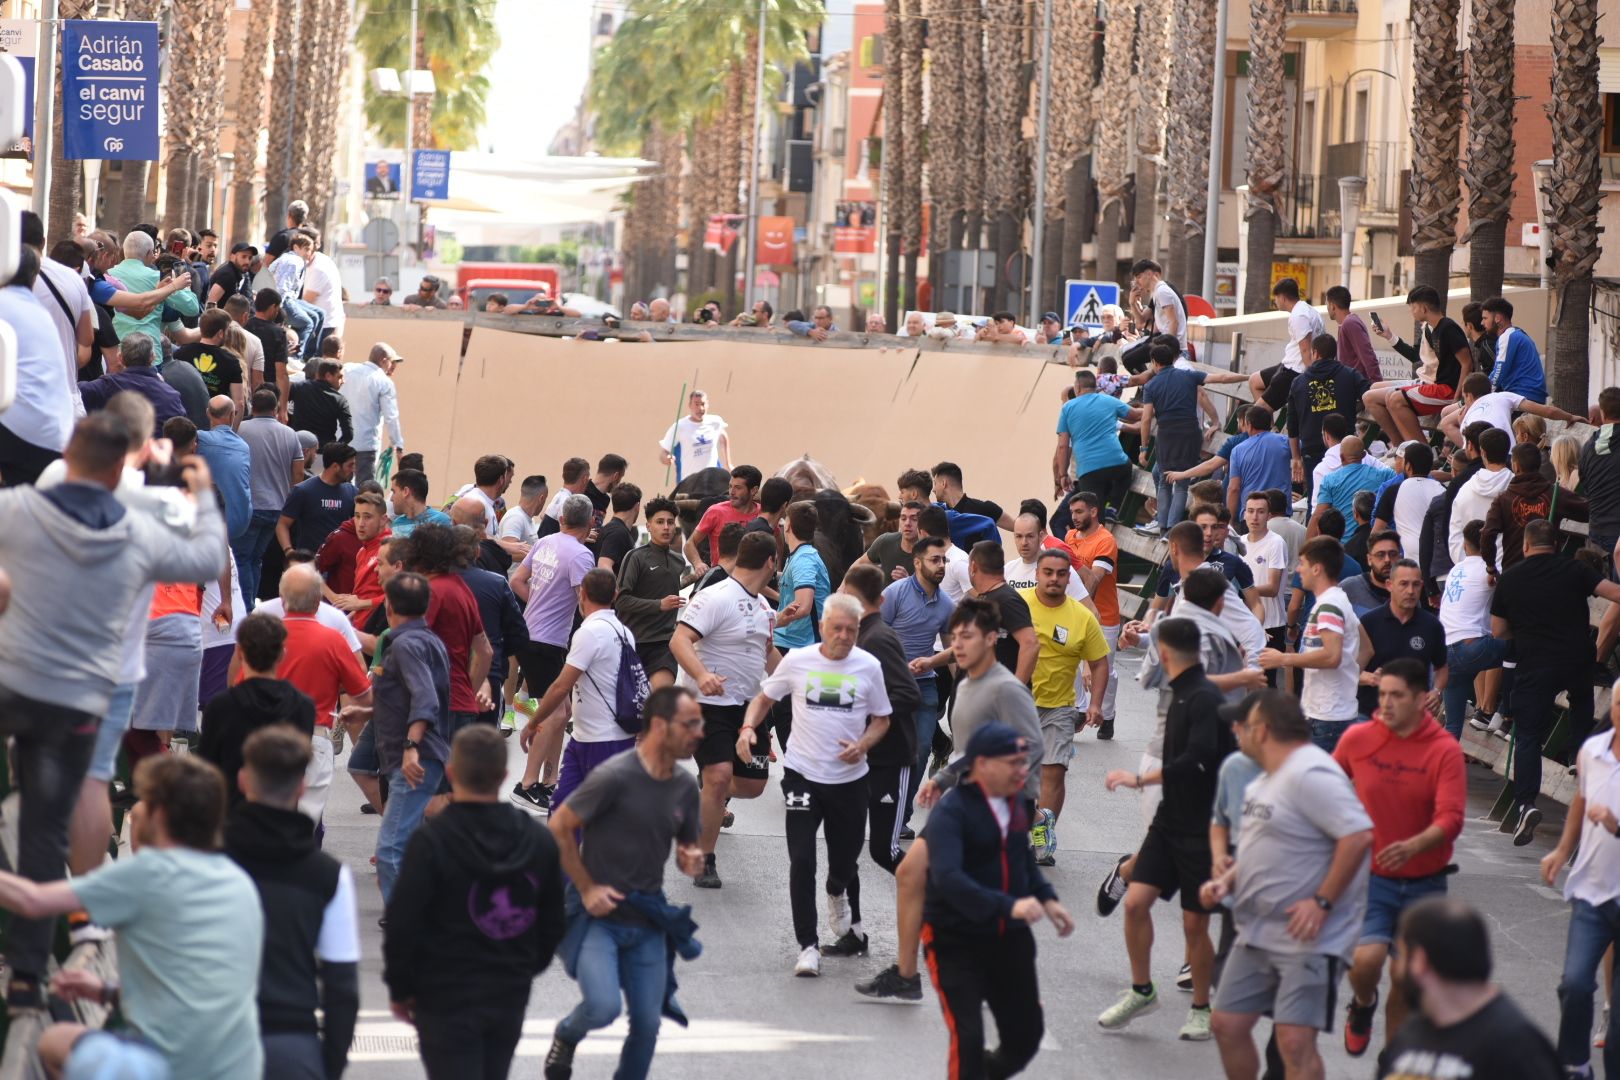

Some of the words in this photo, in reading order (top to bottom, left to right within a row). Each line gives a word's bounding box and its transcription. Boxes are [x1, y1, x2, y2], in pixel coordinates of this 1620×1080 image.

[0, 37, 23, 47] egur
[78, 34, 143, 54] Adrián
[78, 54, 144, 72] Casabó
[79, 84, 96, 100] el
[99, 85, 145, 101] canvi
[79, 103, 145, 126] segur
